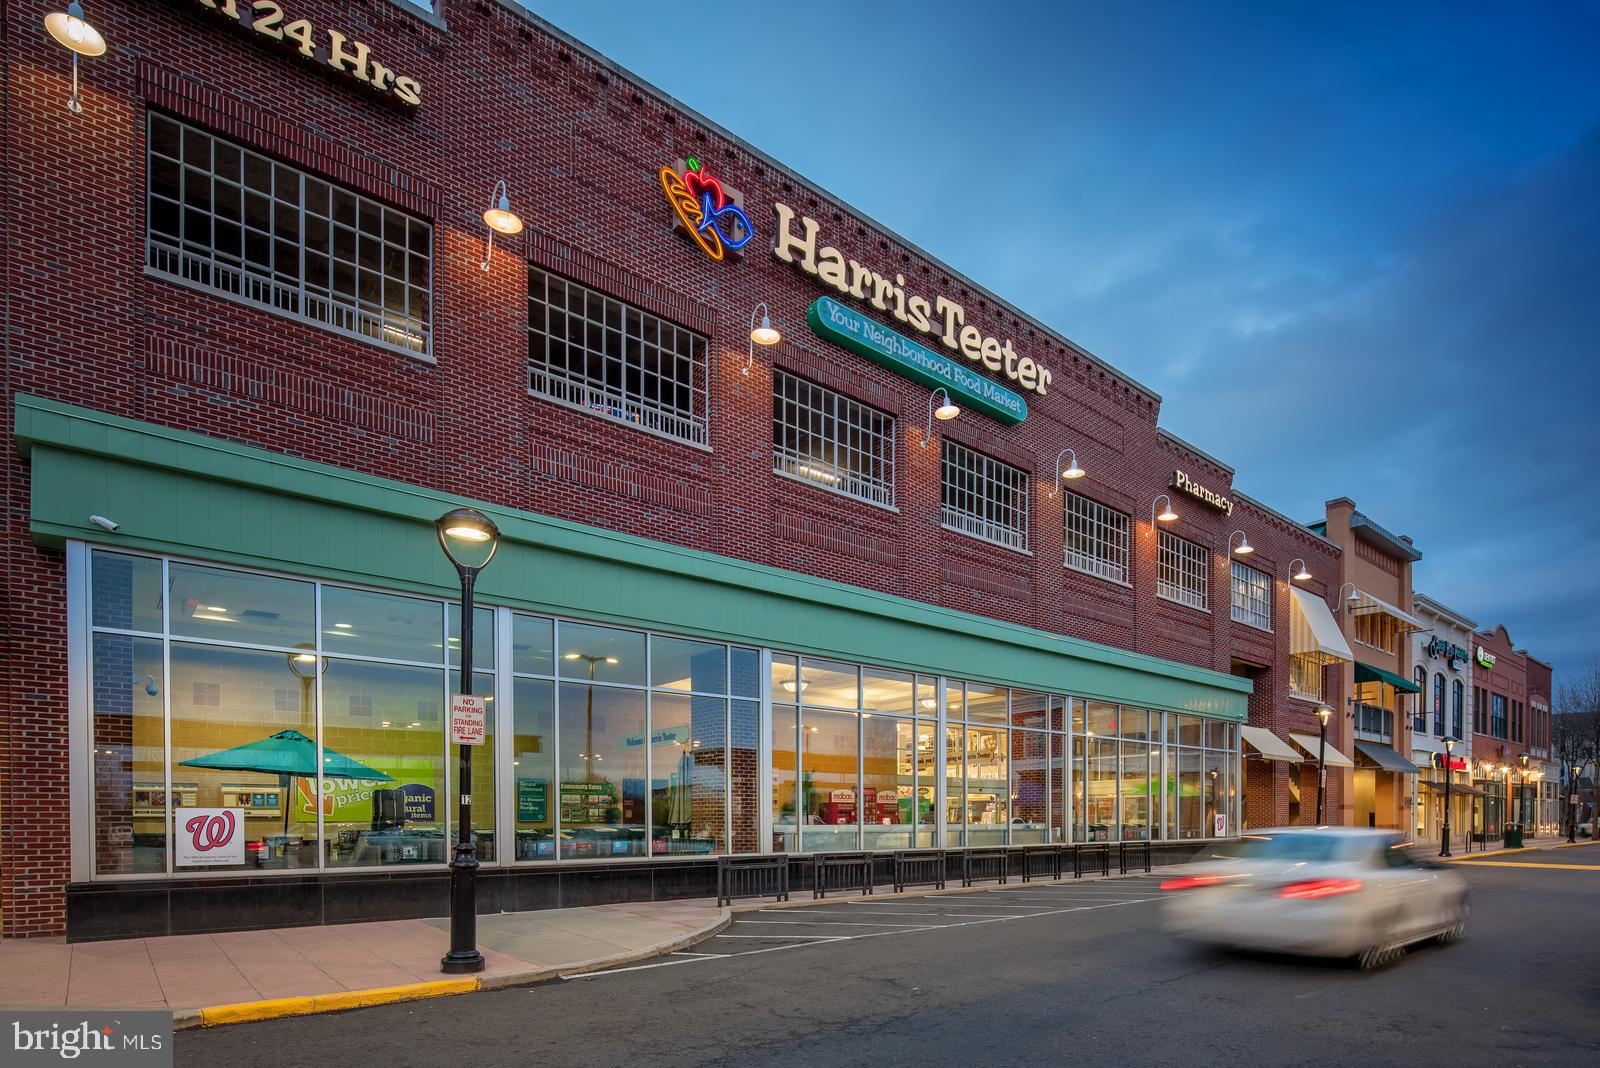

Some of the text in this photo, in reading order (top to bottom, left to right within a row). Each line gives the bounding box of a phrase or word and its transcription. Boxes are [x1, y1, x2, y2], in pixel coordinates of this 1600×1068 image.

[252, 0, 421, 105] 24 Hrs
[774, 202, 1052, 395] Harris Teeter
[826, 301, 1022, 413] Your Neighborhood Food Market
[1176, 469, 1234, 517] Pharmacy
[453, 705, 483, 715] PARKING
[453, 718, 483, 727] STANDING
[462, 698, 475, 706] NO
[453, 726, 483, 736] FIRE LANE
[186, 810, 235, 851] W
